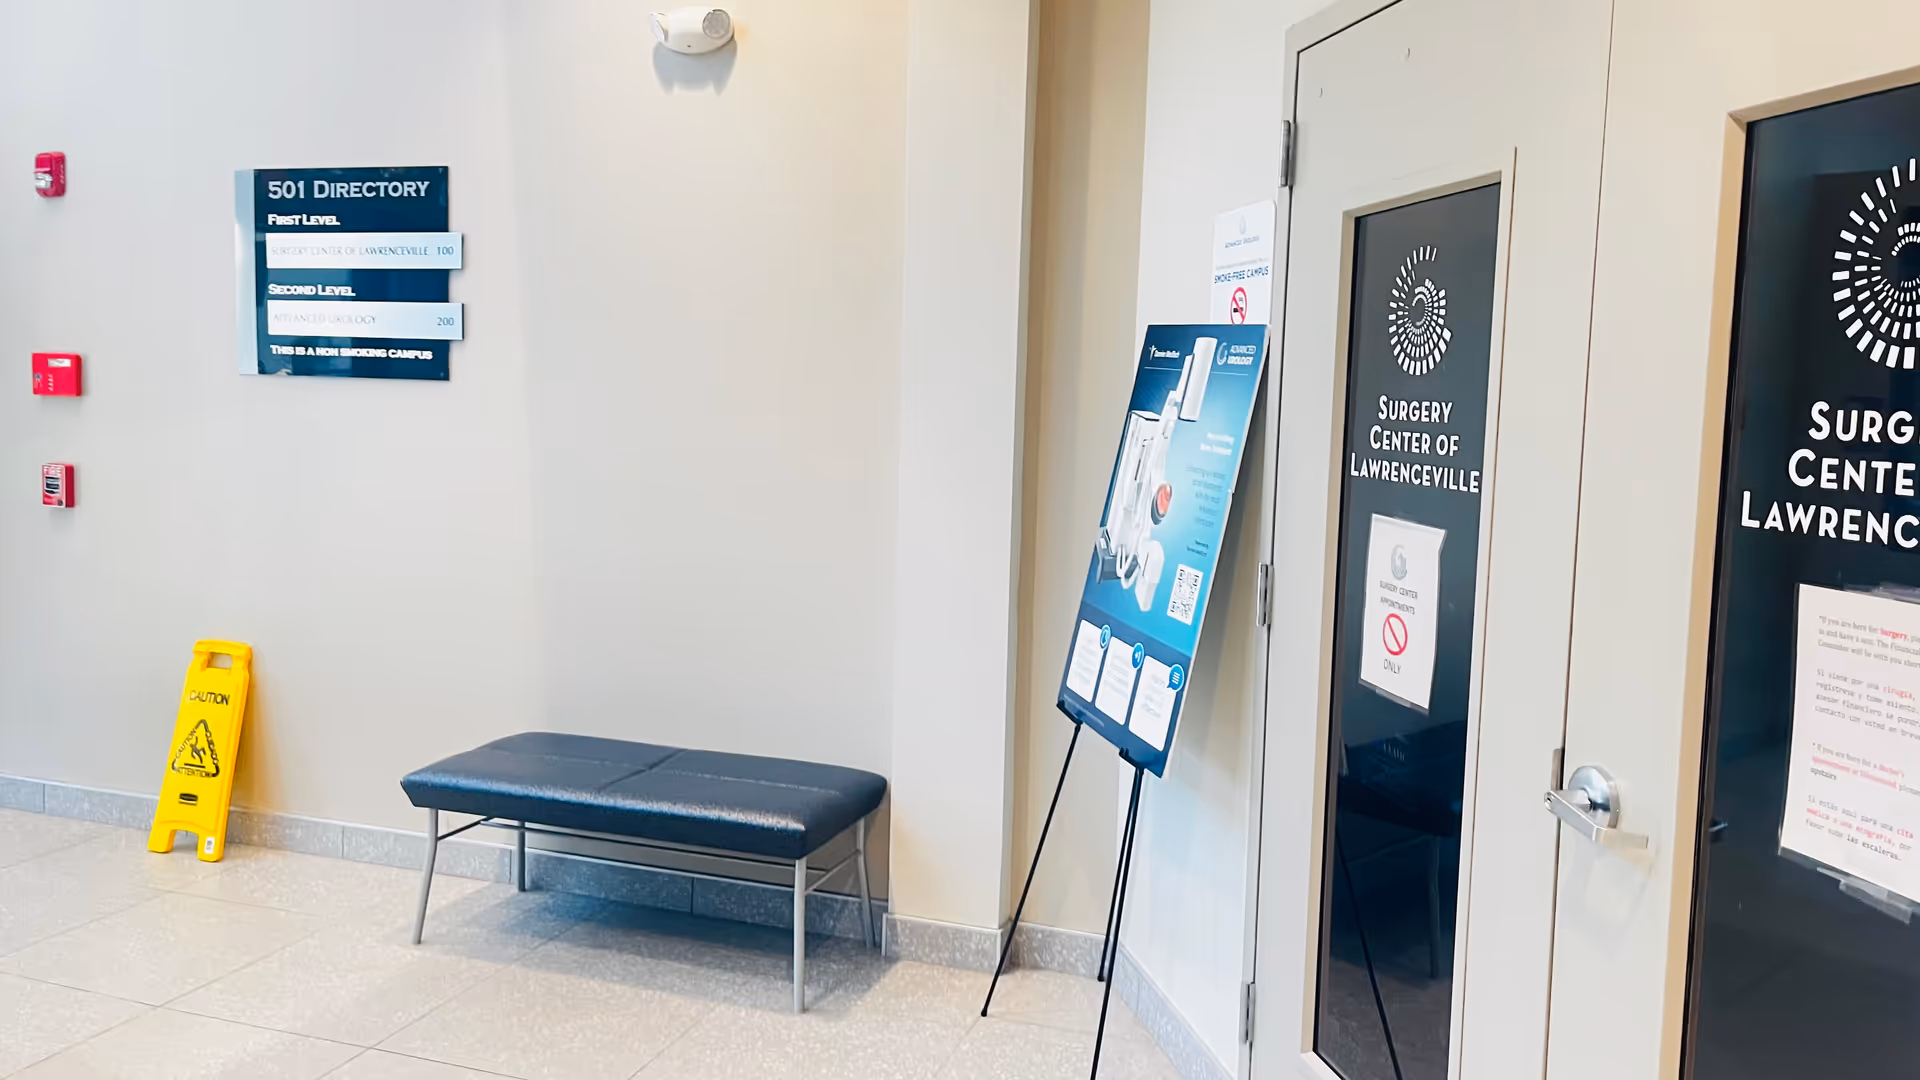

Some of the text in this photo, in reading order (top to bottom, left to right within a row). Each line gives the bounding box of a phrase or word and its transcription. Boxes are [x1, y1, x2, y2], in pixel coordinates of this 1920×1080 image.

[268, 180, 430, 199] 501 DIRECTORY
[267, 213, 341, 226] FIRST LEVEL
[358, 246, 429, 256] LAWRENCEVILLE
[437, 245, 455, 256] 100
[1246, 265, 1269, 279] CAMPUS
[268, 284, 356, 297] SECOND LEVEL
[437, 317, 455, 327] 200
[270, 344, 294, 355] THIS
[306, 347, 315, 356] A
[316, 347, 339, 357] NON
[340, 348, 388, 358] SMOKING
[388, 349, 433, 360] CAMPUS
[1378, 394, 1453, 423] SURGERY
[1808, 400, 1920, 445] SURG
[1369, 424, 1459, 457] CENTER OF
[1350, 452, 1480, 493] LAWRENCEVILLE
[1399, 587, 1418, 600] CENTER
[1383, 658, 1402, 675] ONLY
[190, 690, 230, 706] CAUTION
